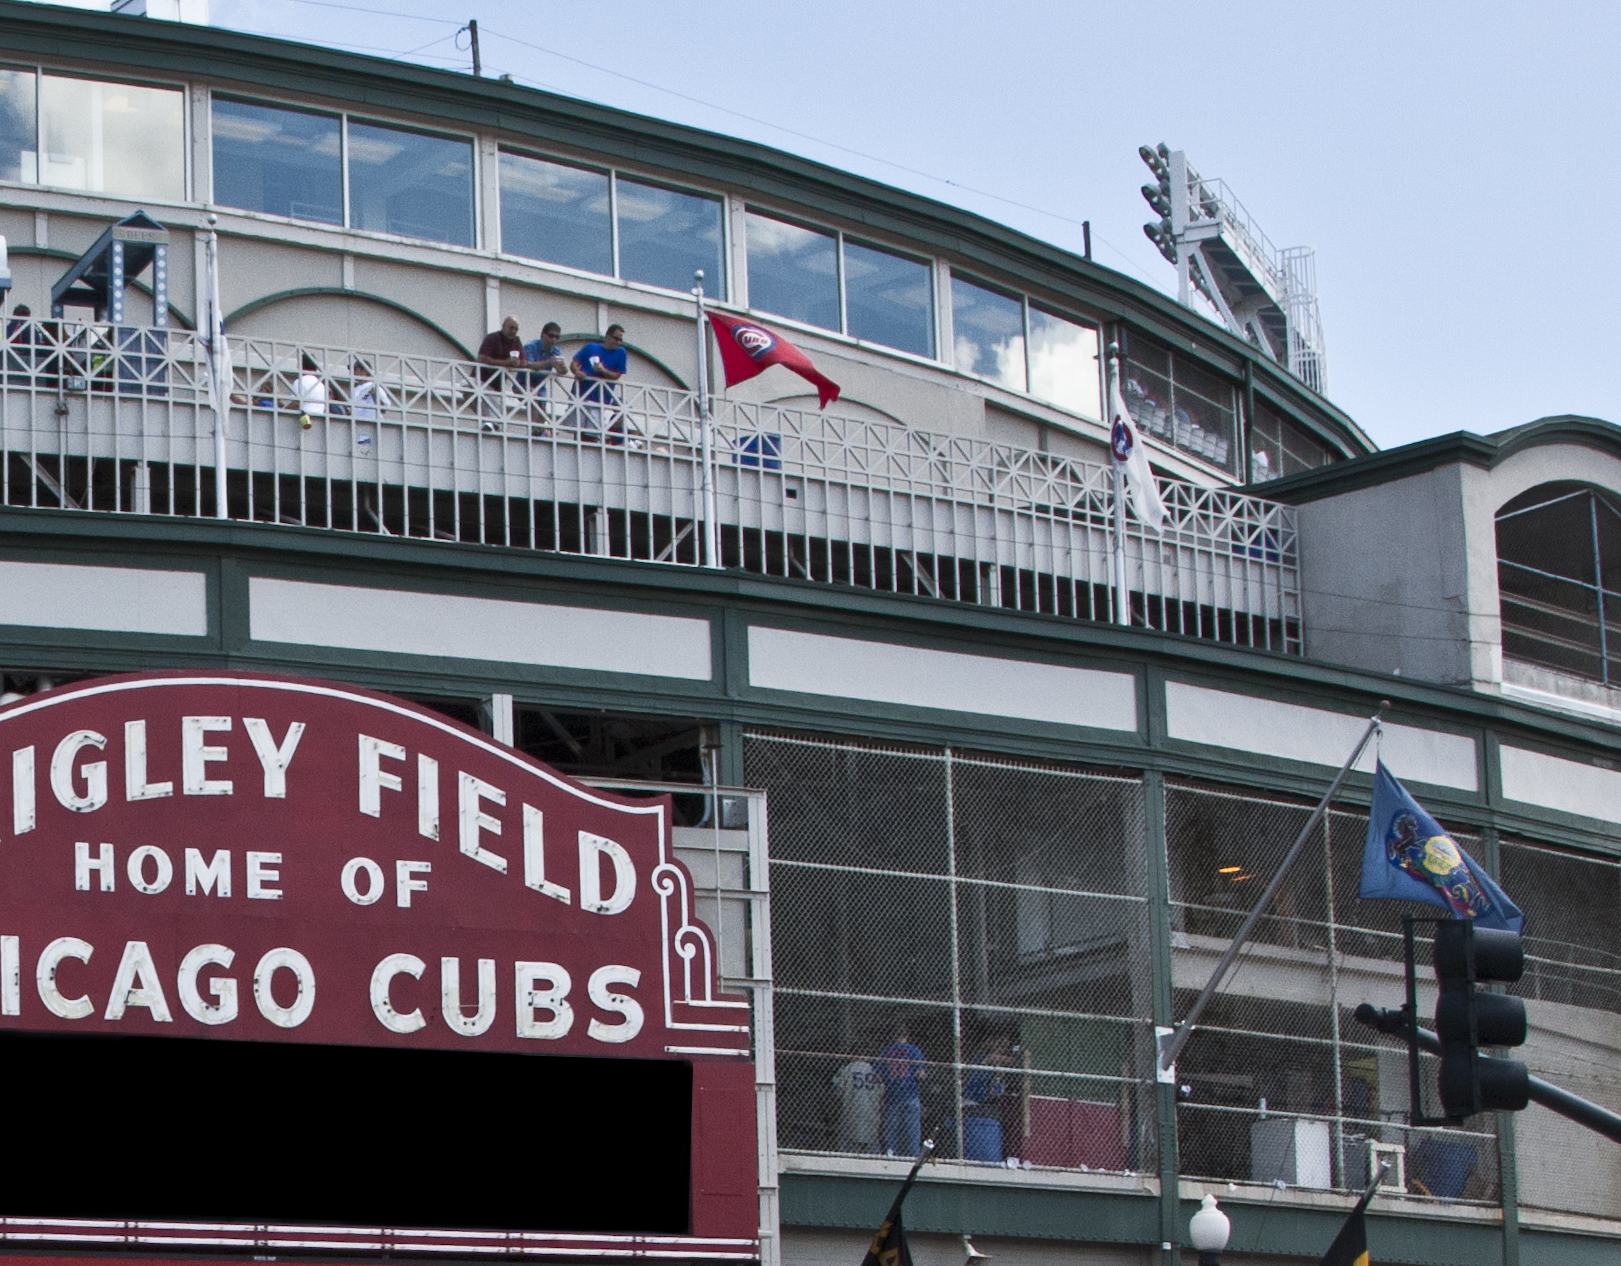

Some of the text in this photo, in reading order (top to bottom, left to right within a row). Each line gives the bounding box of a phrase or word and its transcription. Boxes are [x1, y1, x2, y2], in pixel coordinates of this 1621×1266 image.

[358, 732, 638, 915] FIELD
[75, 841, 432, 908] HOME OF
[370, 951, 644, 1043] CUBS
